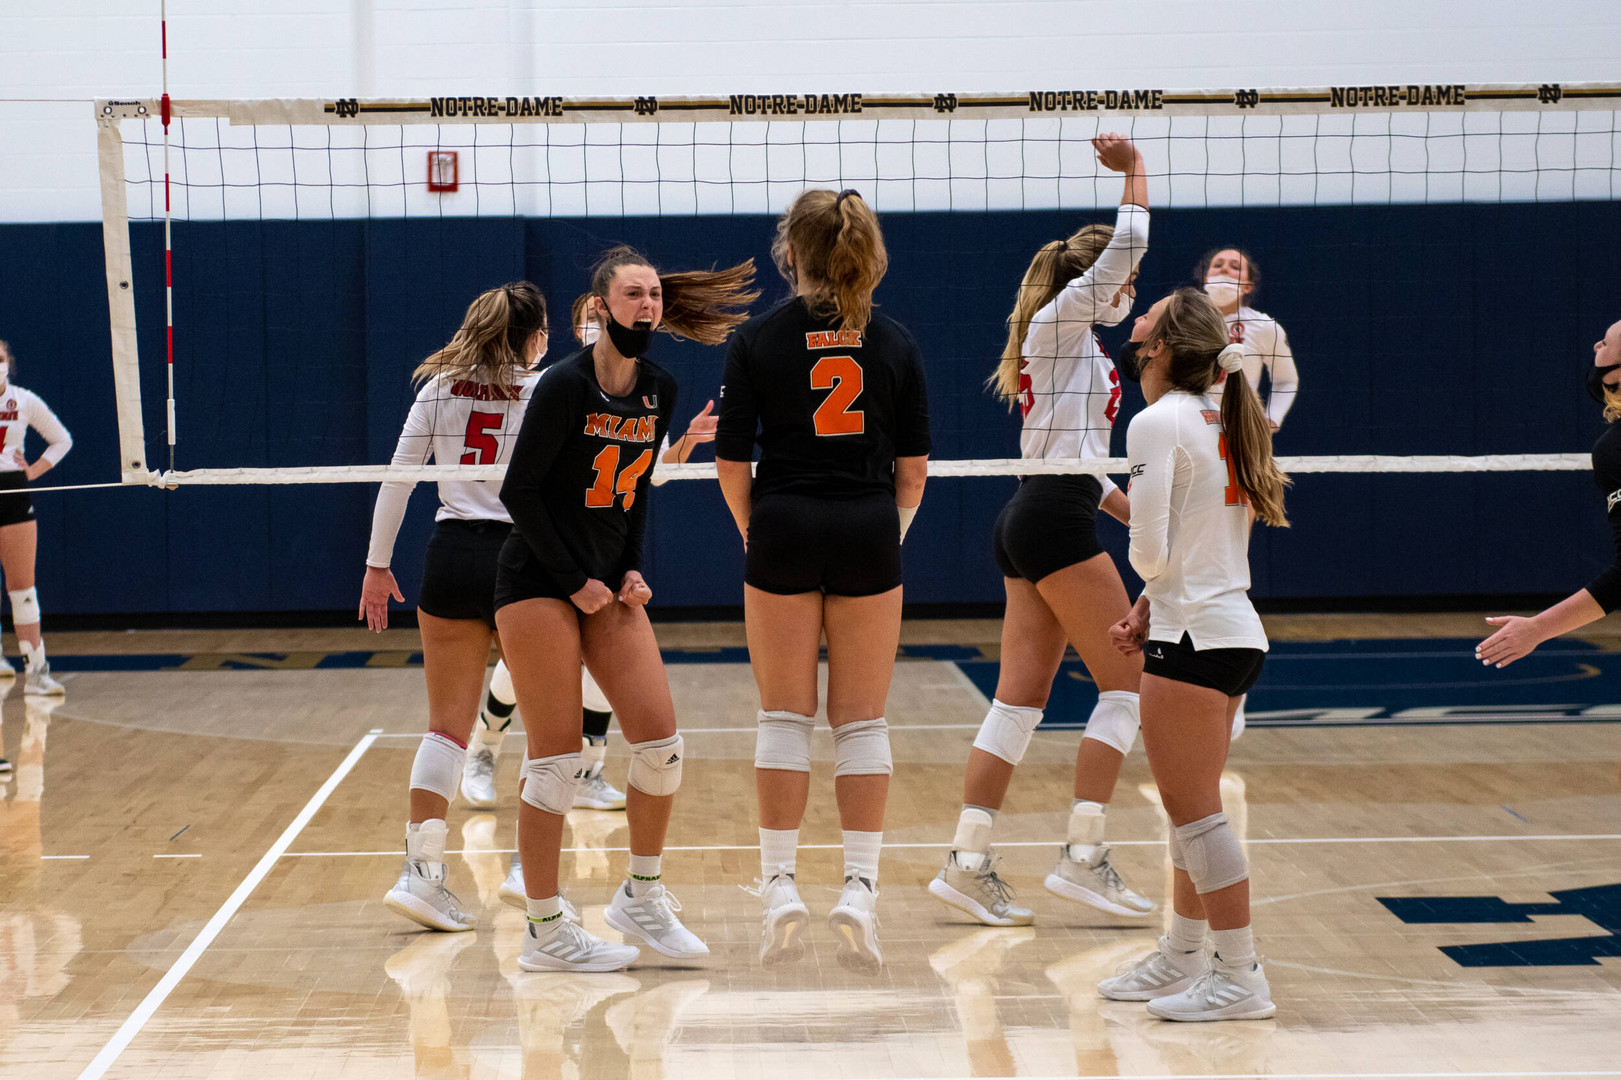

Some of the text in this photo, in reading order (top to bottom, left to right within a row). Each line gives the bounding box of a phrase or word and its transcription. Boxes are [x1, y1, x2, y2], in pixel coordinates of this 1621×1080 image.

[729, 94, 863, 115] NOTRE DAME
[1029, 90, 1163, 111] NOTRE DAME
[1330, 85, 1465, 107] NOTRE DAME
[430, 97, 563, 117] NOTRE DAME
[642, 394, 658, 409] U
[810, 355, 865, 437] 2
[459, 410, 505, 466] 5
[584, 444, 654, 513] 14
